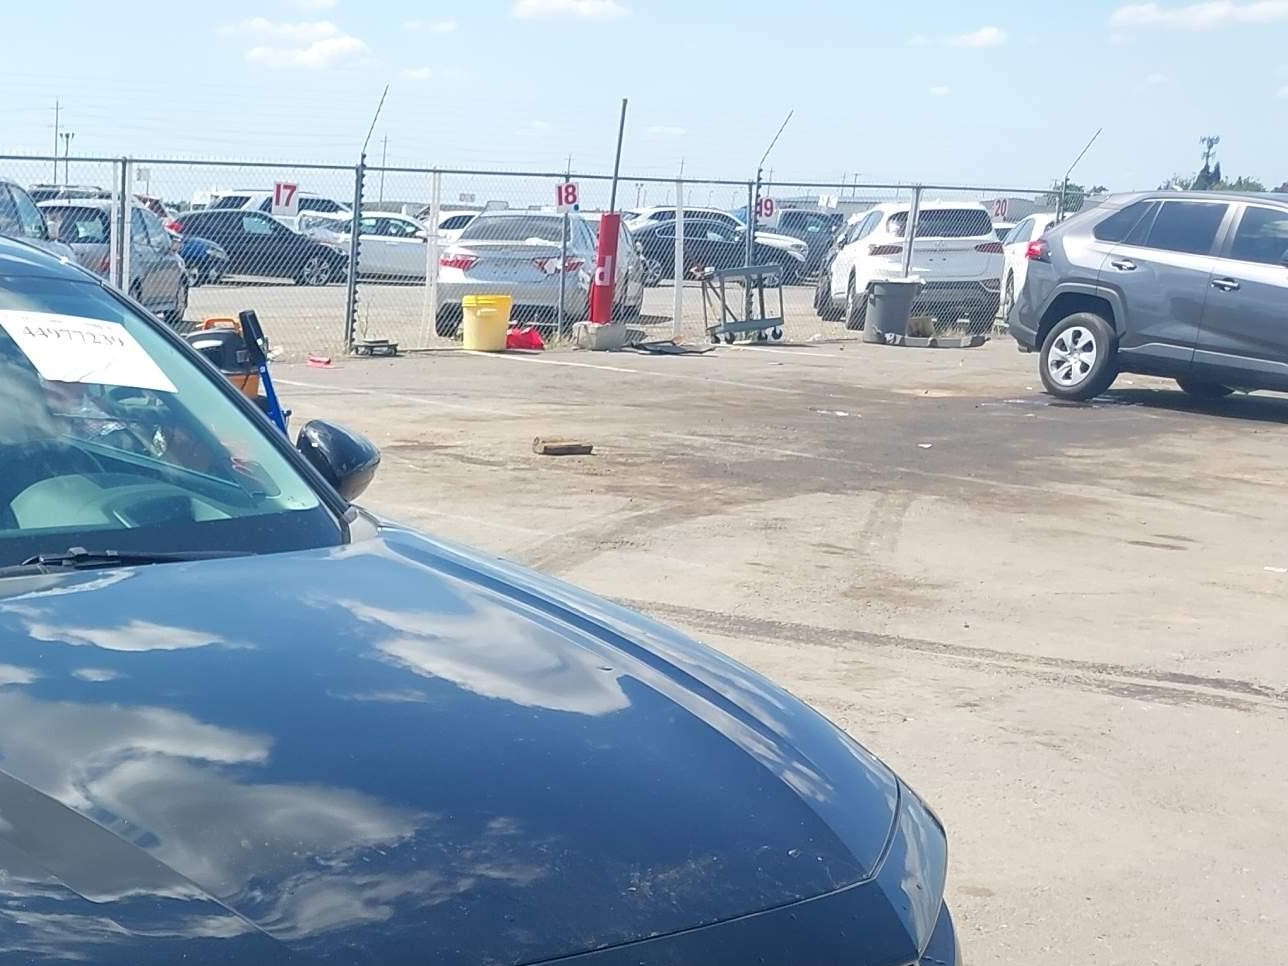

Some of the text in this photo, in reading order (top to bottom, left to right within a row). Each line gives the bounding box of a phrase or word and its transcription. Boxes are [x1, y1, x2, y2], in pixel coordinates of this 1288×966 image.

[275, 183, 297, 207] 17
[557, 184, 577, 206] 18
[758, 199, 774, 217] 19
[994, 199, 1007, 217] 20
